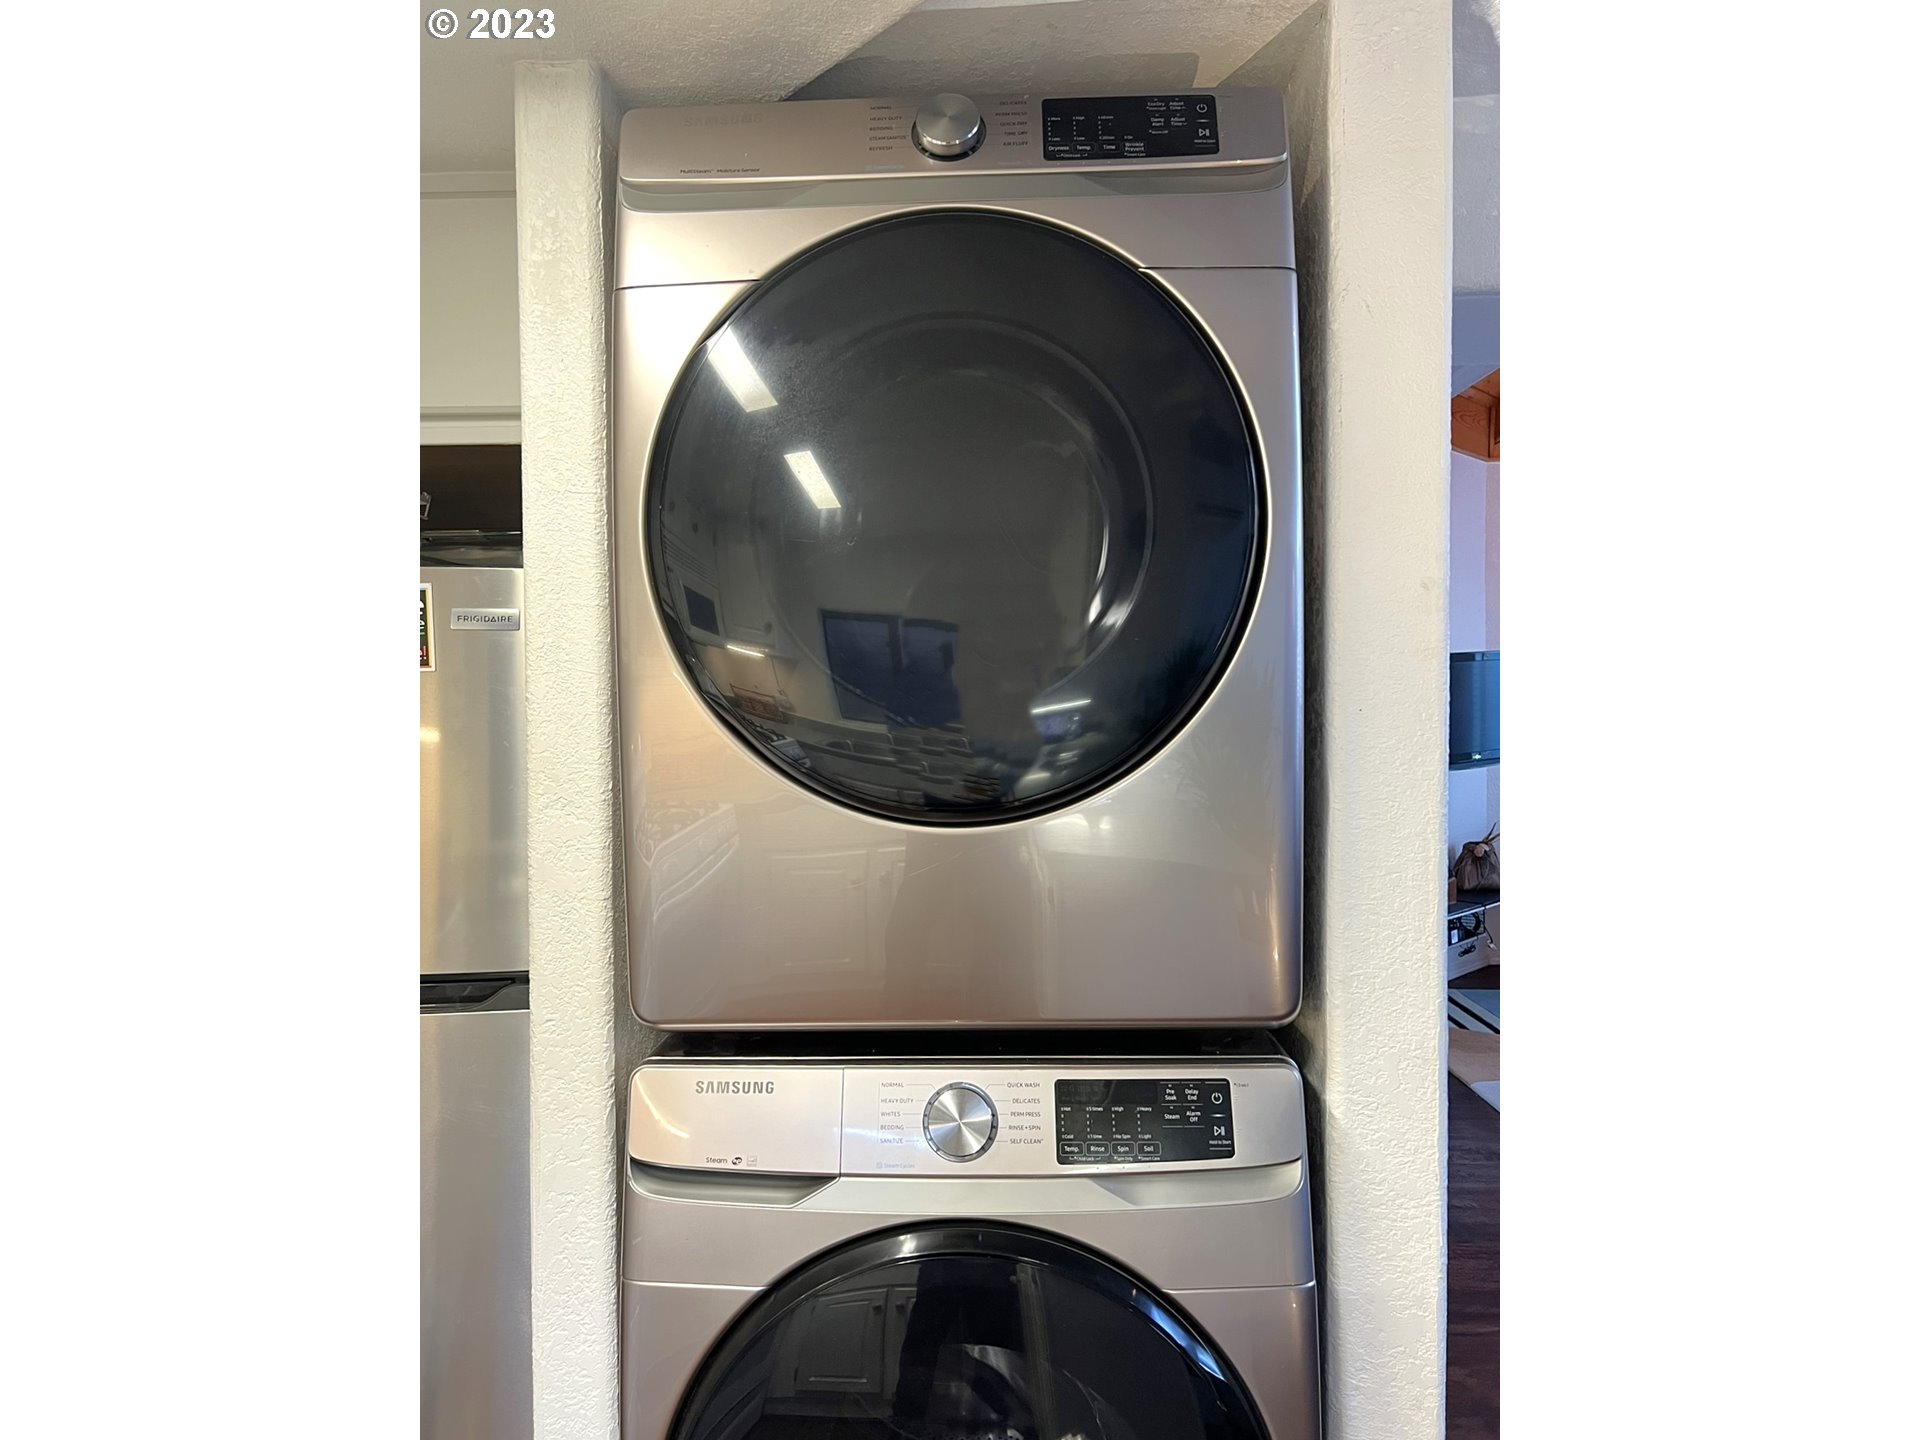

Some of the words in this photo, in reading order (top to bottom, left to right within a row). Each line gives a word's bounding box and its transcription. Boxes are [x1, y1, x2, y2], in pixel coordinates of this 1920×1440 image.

[457, 615, 514, 623] FRIGIDAIRE
[695, 1080, 775, 1095] SAMSUNG
[1064, 1145, 1080, 1153] Temp.
[1117, 1145, 1129, 1153] Spin
[705, 1156, 728, 1164] Steam
